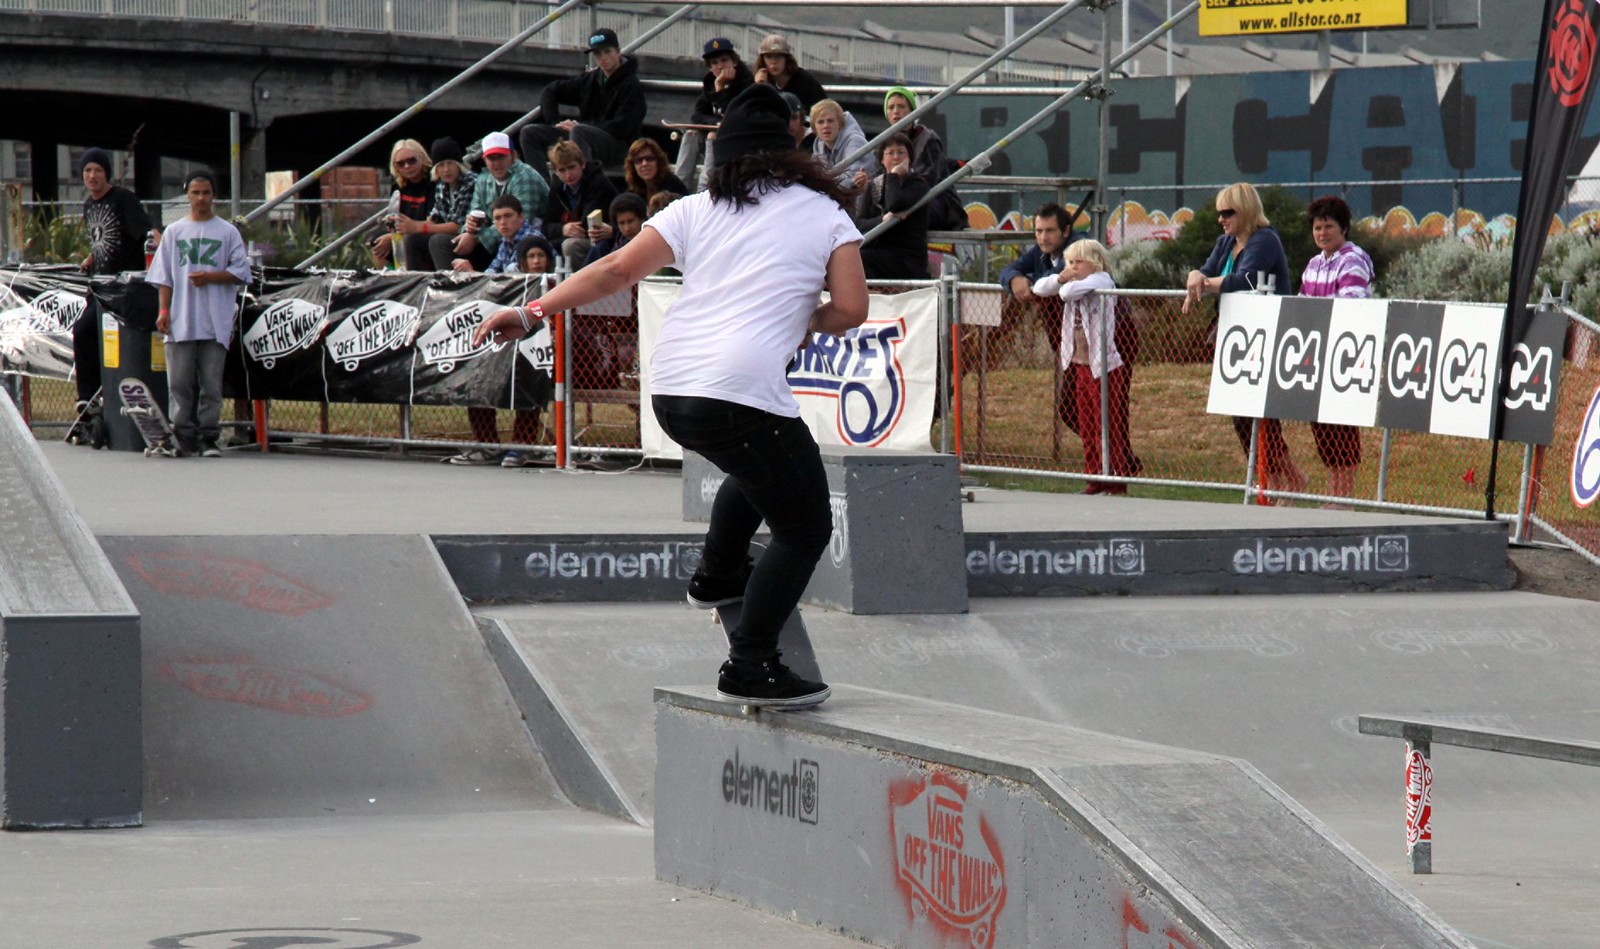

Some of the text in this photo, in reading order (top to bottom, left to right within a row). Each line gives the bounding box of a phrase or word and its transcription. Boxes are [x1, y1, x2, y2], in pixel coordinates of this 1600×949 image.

[176, 237, 223, 267] NZ
[264, 301, 294, 330] VANS
[270, 326, 292, 351] THE
[352, 303, 387, 332] VANS
[358, 324, 380, 352] THE
[446, 303, 484, 333] VANS
[1219, 325, 1267, 385] C4
[1275, 327, 1321, 391] C4
[1330, 331, 1376, 393] C4
[1387, 333, 1432, 399] C4
[1440, 338, 1488, 404] C4
[1503, 342, 1552, 411] C4
[525, 543, 673, 578] element
[966, 541, 1107, 575] element
[1233, 537, 1373, 574] element
[722, 744, 798, 818] element
[926, 793, 964, 850] VANS
[903, 832, 928, 880] OFF
[929, 842, 957, 911] THE
